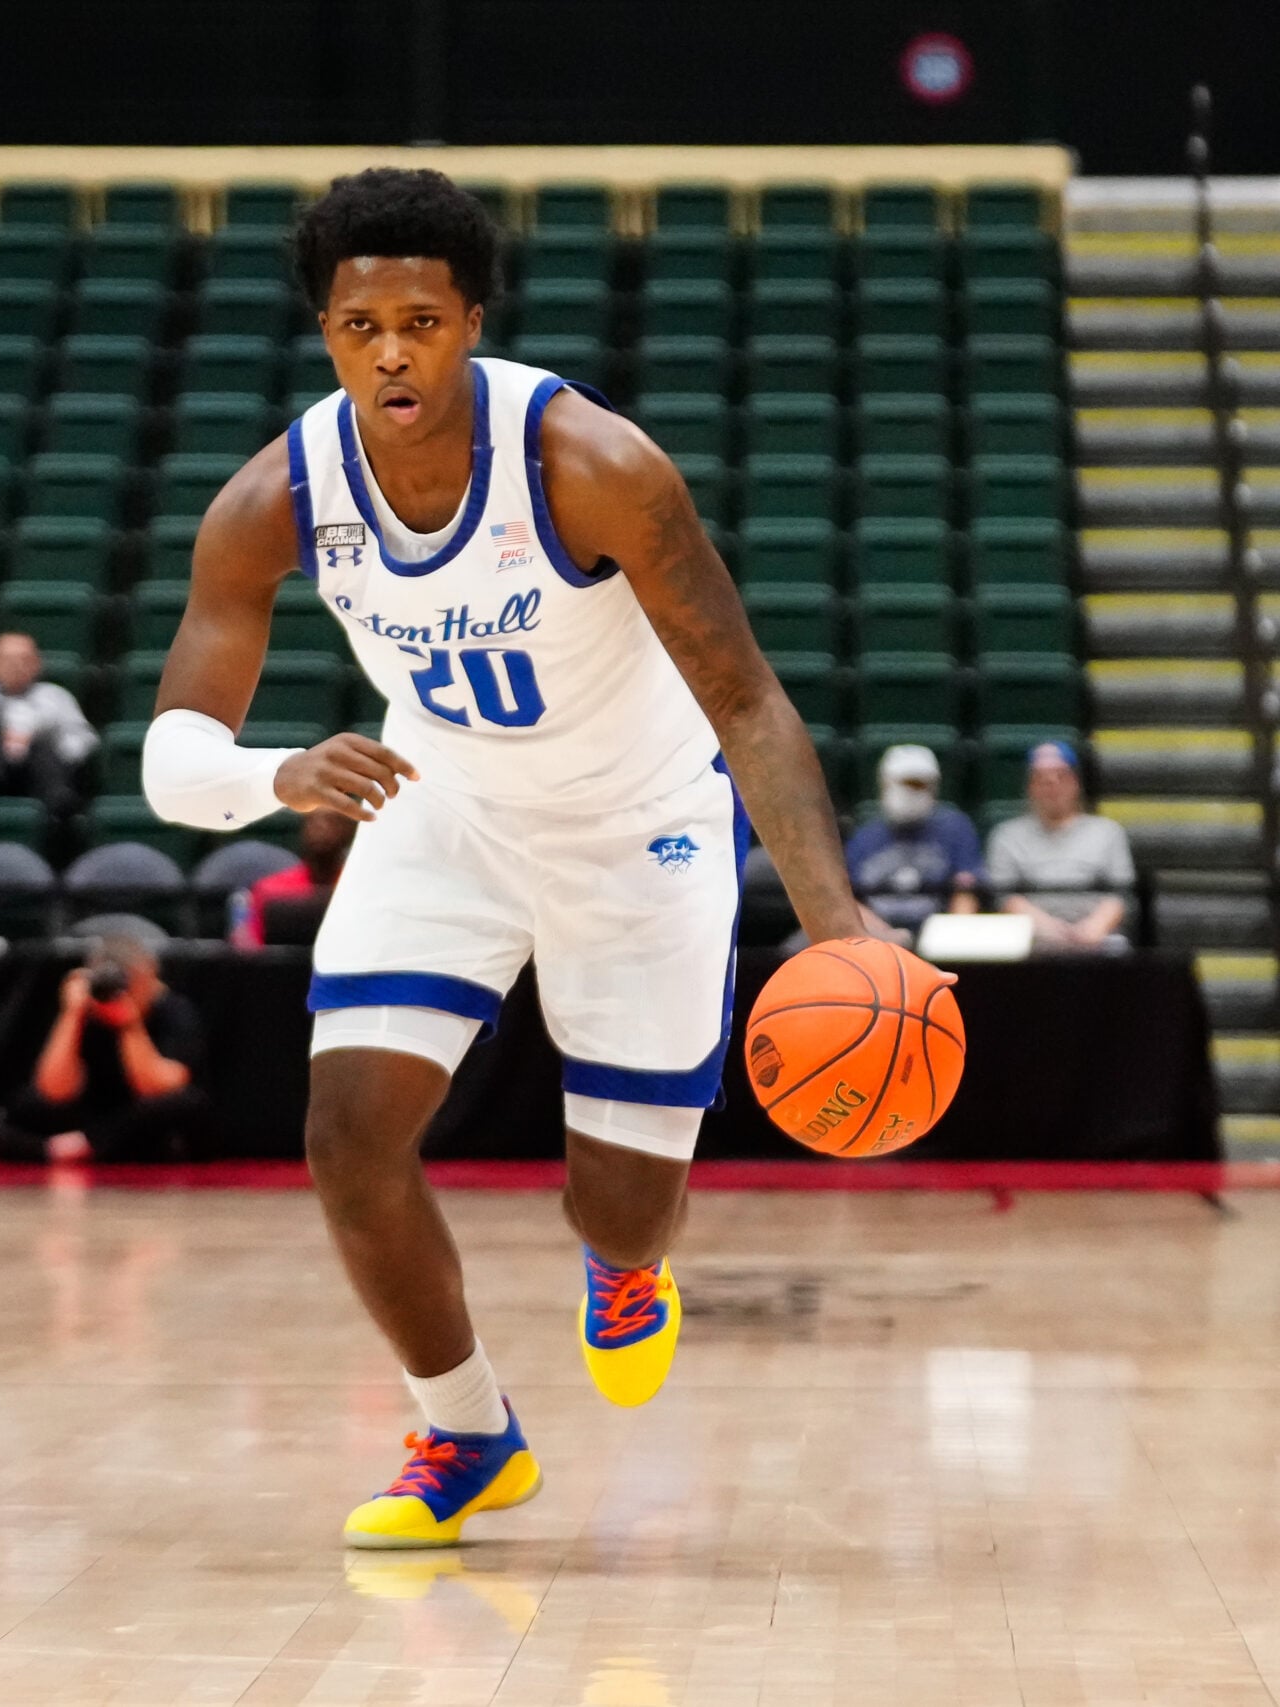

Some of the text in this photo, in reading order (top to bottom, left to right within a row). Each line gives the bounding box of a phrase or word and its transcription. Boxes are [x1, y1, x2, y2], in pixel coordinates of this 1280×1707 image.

[316, 535, 364, 547] CHANGE
[500, 548, 526, 559] BIG
[497, 556, 534, 568] EAST
[434, 588, 541, 642] Hall
[397, 644, 547, 728] 20
